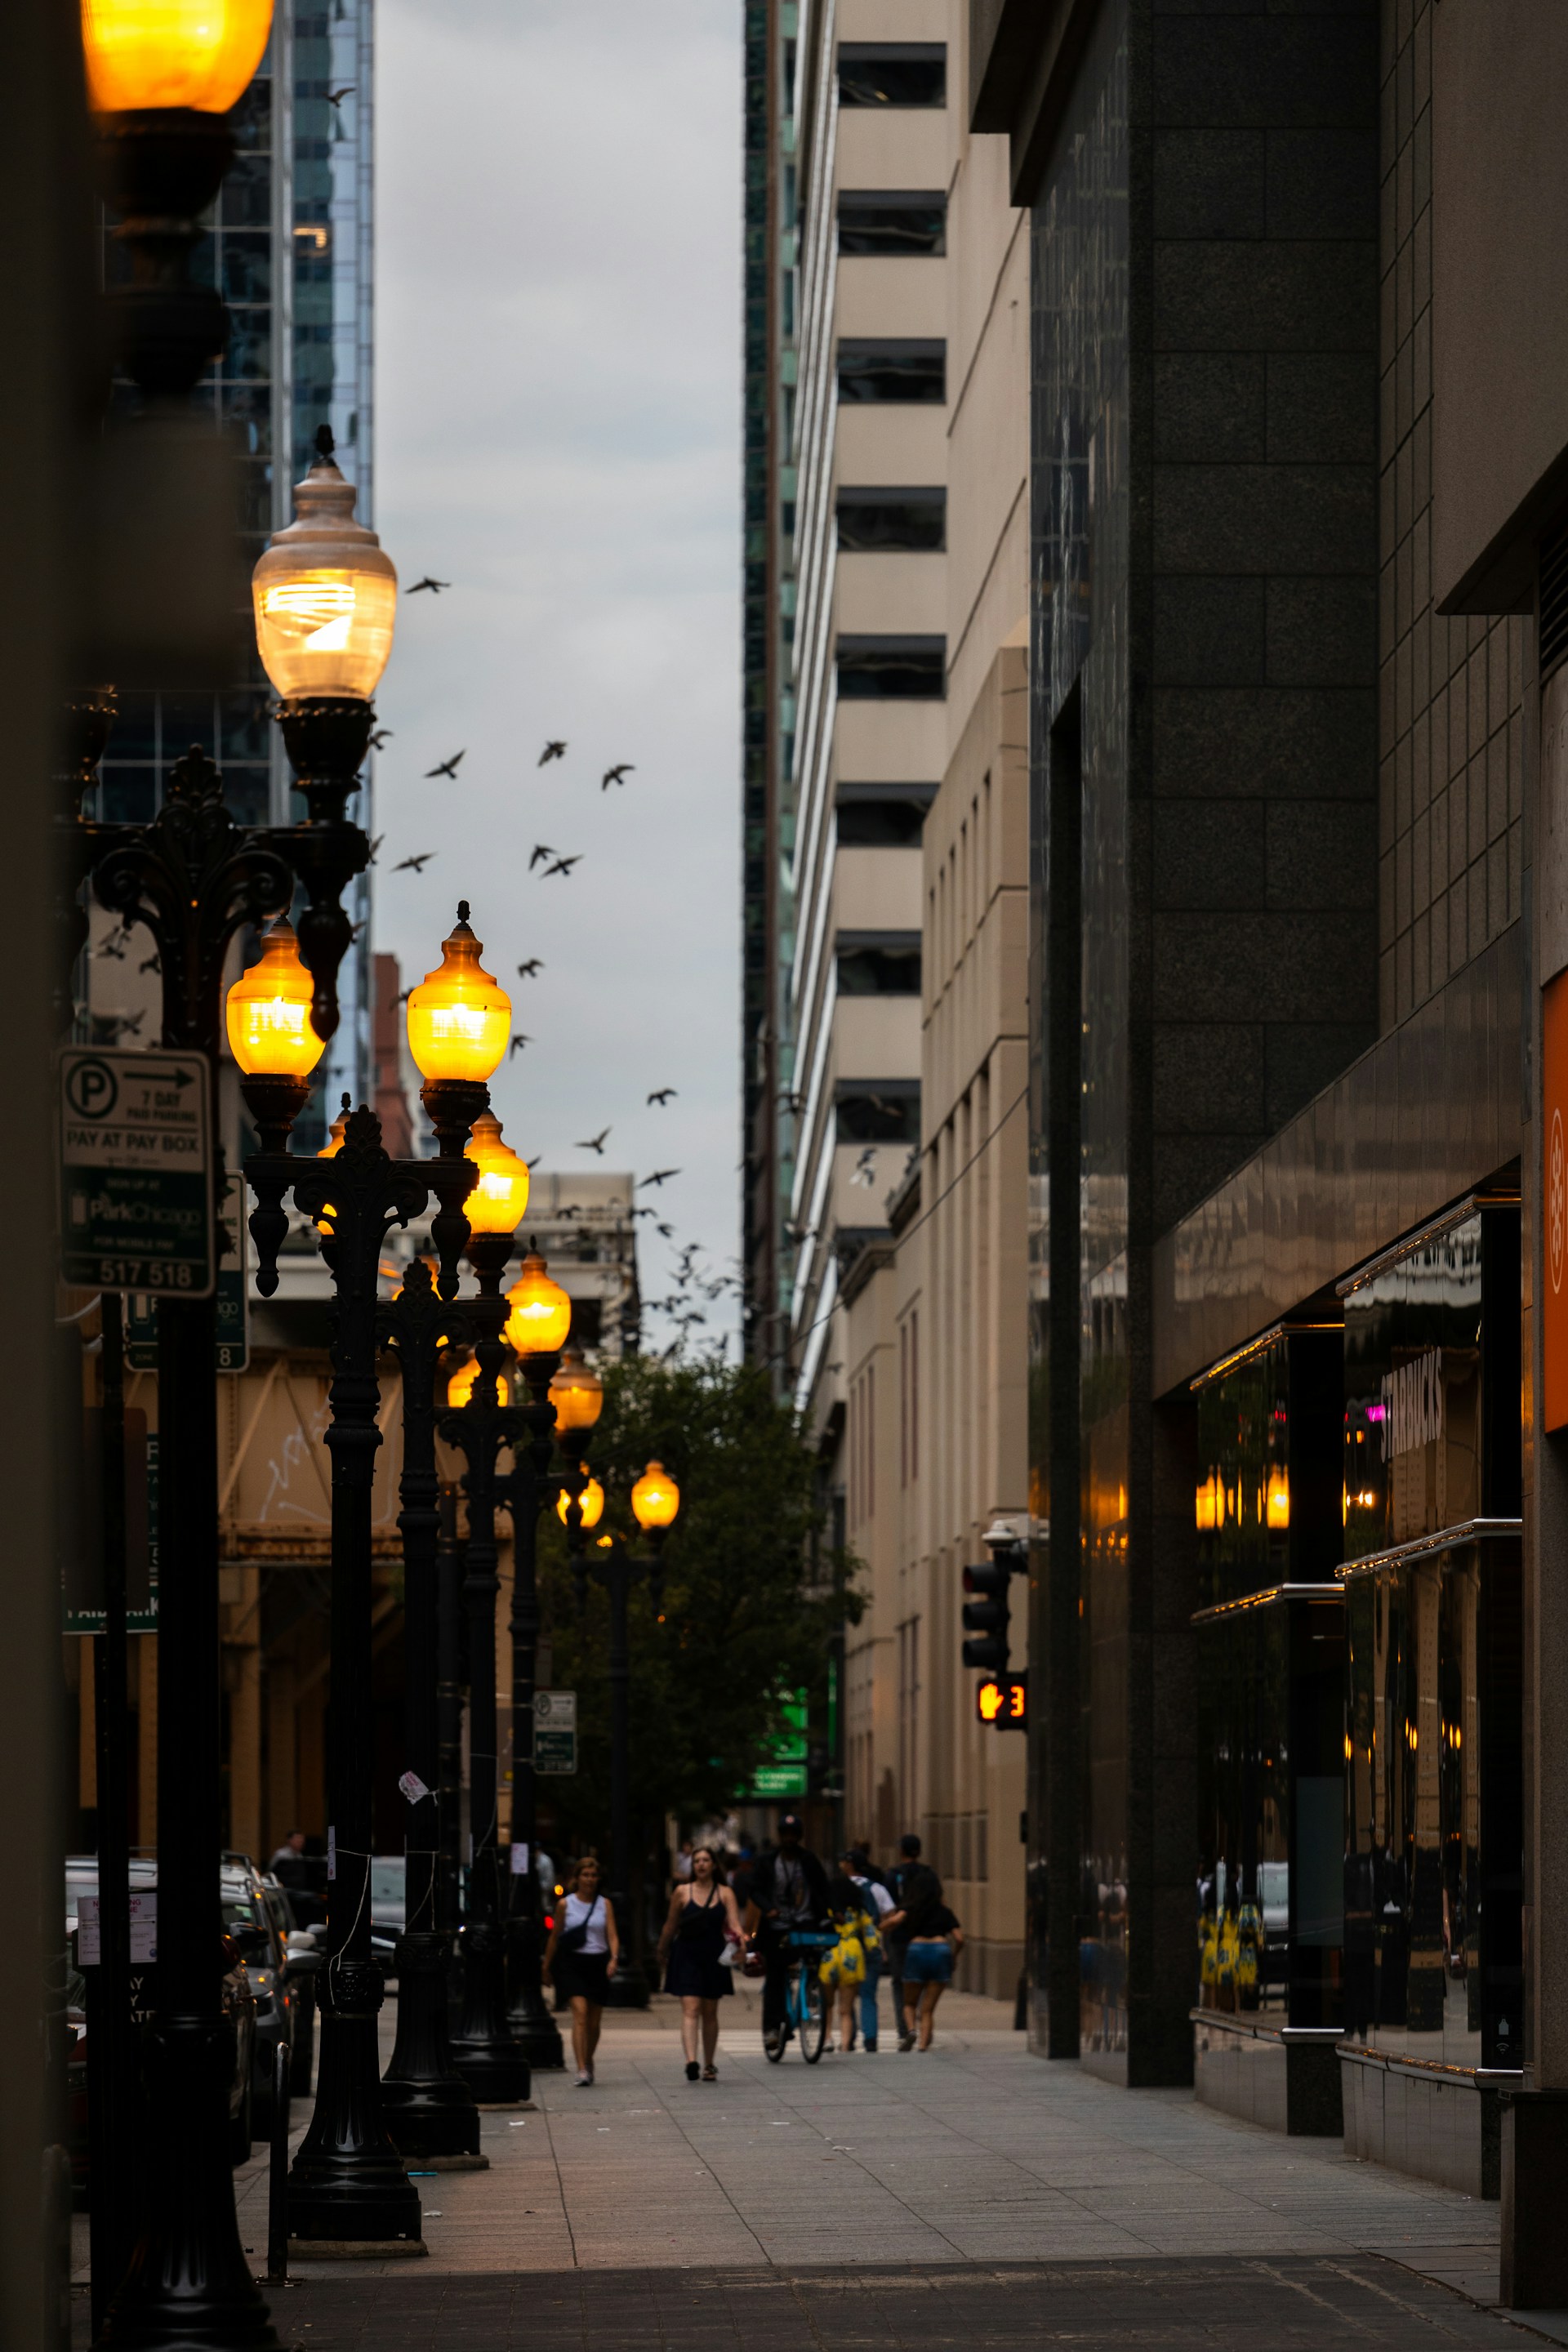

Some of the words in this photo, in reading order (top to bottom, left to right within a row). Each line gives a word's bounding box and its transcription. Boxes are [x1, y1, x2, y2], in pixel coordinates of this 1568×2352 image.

[81, 1071, 106, 1107] P
[143, 1089, 150, 1106] 7
[155, 1092, 181, 1107] DAY
[67, 1130, 98, 1147] PAY
[102, 1132, 121, 1147] AT
[126, 1133, 157, 1149] PAY
[163, 1134, 198, 1152] BOX
[90, 1198, 202, 1230] ParkChicago
[100, 1259, 143, 1285] 517
[148, 1263, 193, 1288] 518
[1380, 1346, 1441, 1463] STARBUCKS
[1009, 1685, 1025, 1717] 3
